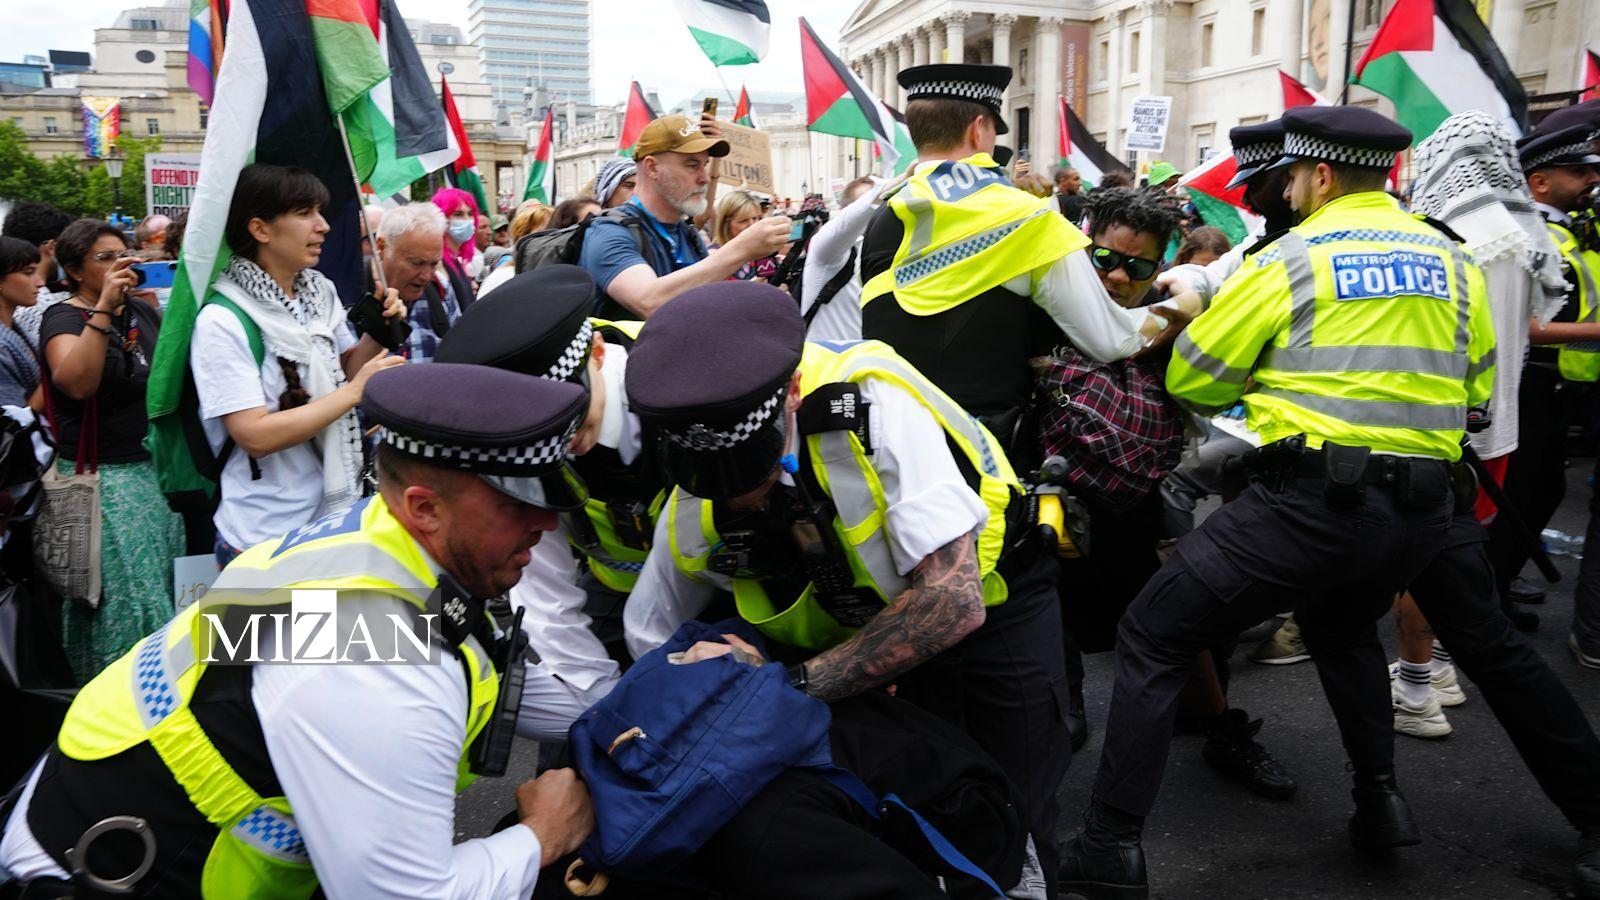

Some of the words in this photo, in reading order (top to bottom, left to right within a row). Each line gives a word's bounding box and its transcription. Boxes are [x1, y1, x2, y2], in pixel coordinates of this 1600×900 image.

[1066, 43, 1076, 78] Velasco
[1134, 107, 1154, 116] HANDS
[1156, 108, 1168, 117] OFF
[1132, 116, 1166, 126] PALESTINE
[1135, 125, 1159, 133] ACTION
[152, 169, 188, 186] DEFEND
[723, 160, 761, 182] ILTON
[934, 162, 999, 200] POL
[153, 185, 190, 206] RIGHT
[1336, 253, 1444, 268] METROPOLTAN
[1336, 264, 1448, 296] POLICE
[830, 399, 843, 414] NE
